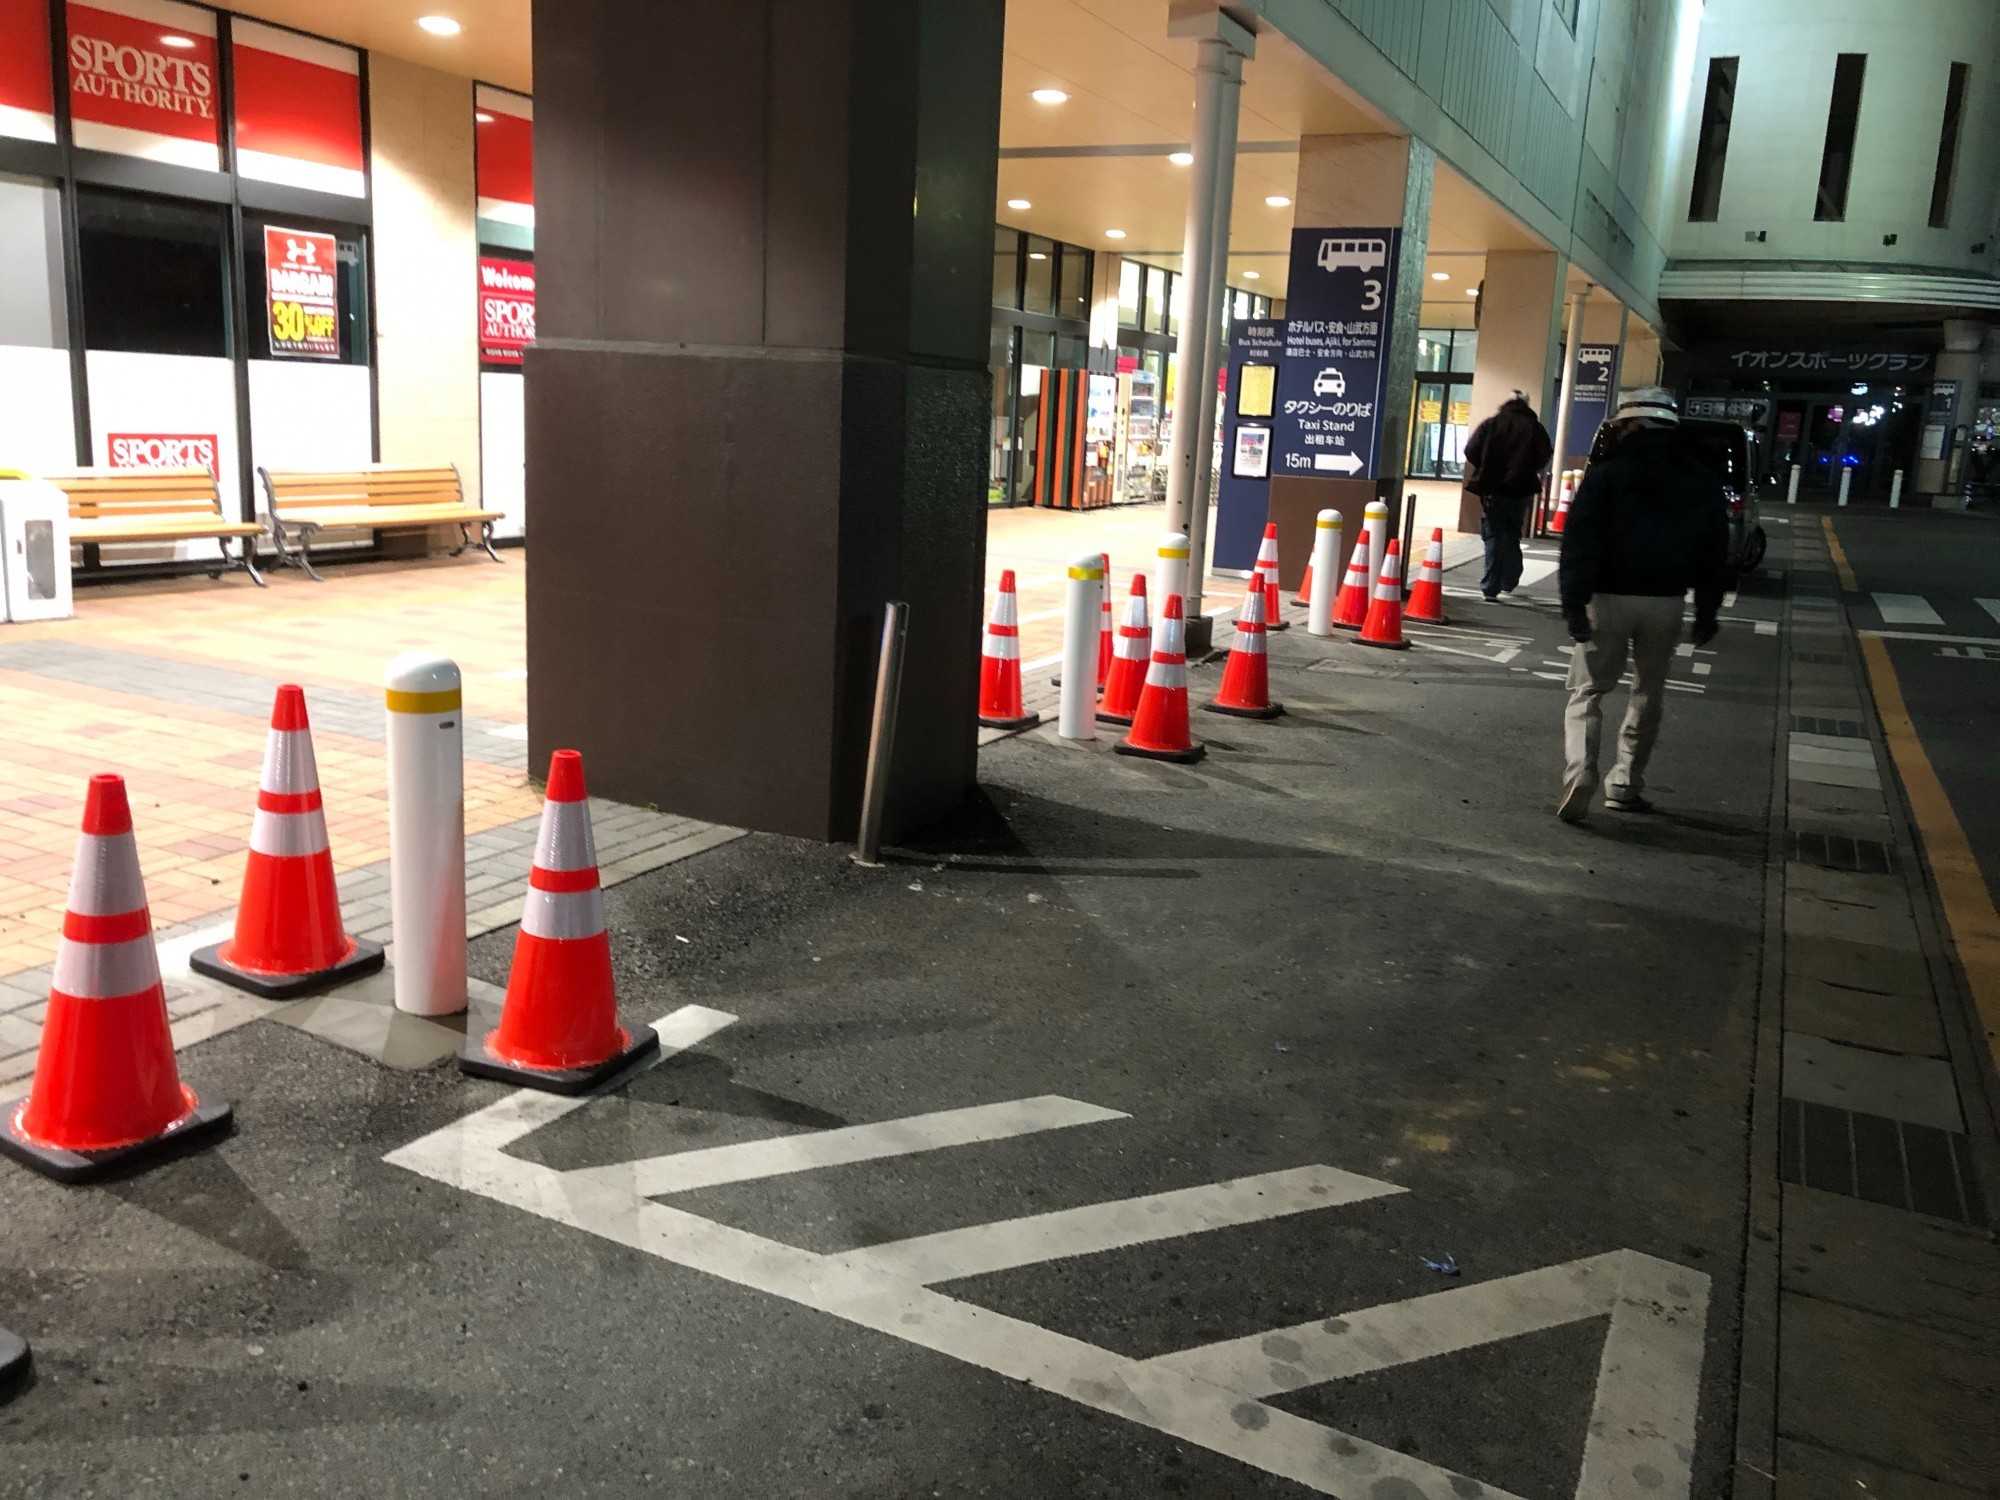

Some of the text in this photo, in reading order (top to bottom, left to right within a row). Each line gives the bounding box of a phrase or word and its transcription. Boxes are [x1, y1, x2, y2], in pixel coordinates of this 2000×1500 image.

[70, 34, 211, 97] SPORTS
[73, 72, 211, 119] AUTHORITY
[1361, 279, 1382, 311] 3
[1238, 338, 1283, 347] Bus Schedule
[1286, 336, 1305, 346] Hotel
[1731, 351, 1929, 371] イオンスポーツクラブ
[1597, 366, 1609, 382] 2
[1284, 400, 1373, 418] タクシーのりば
[1297, 418, 1356, 432] Taxi Stand
[113, 438, 214, 466] SPORTS
[1284, 452, 1312, 469] 15m
